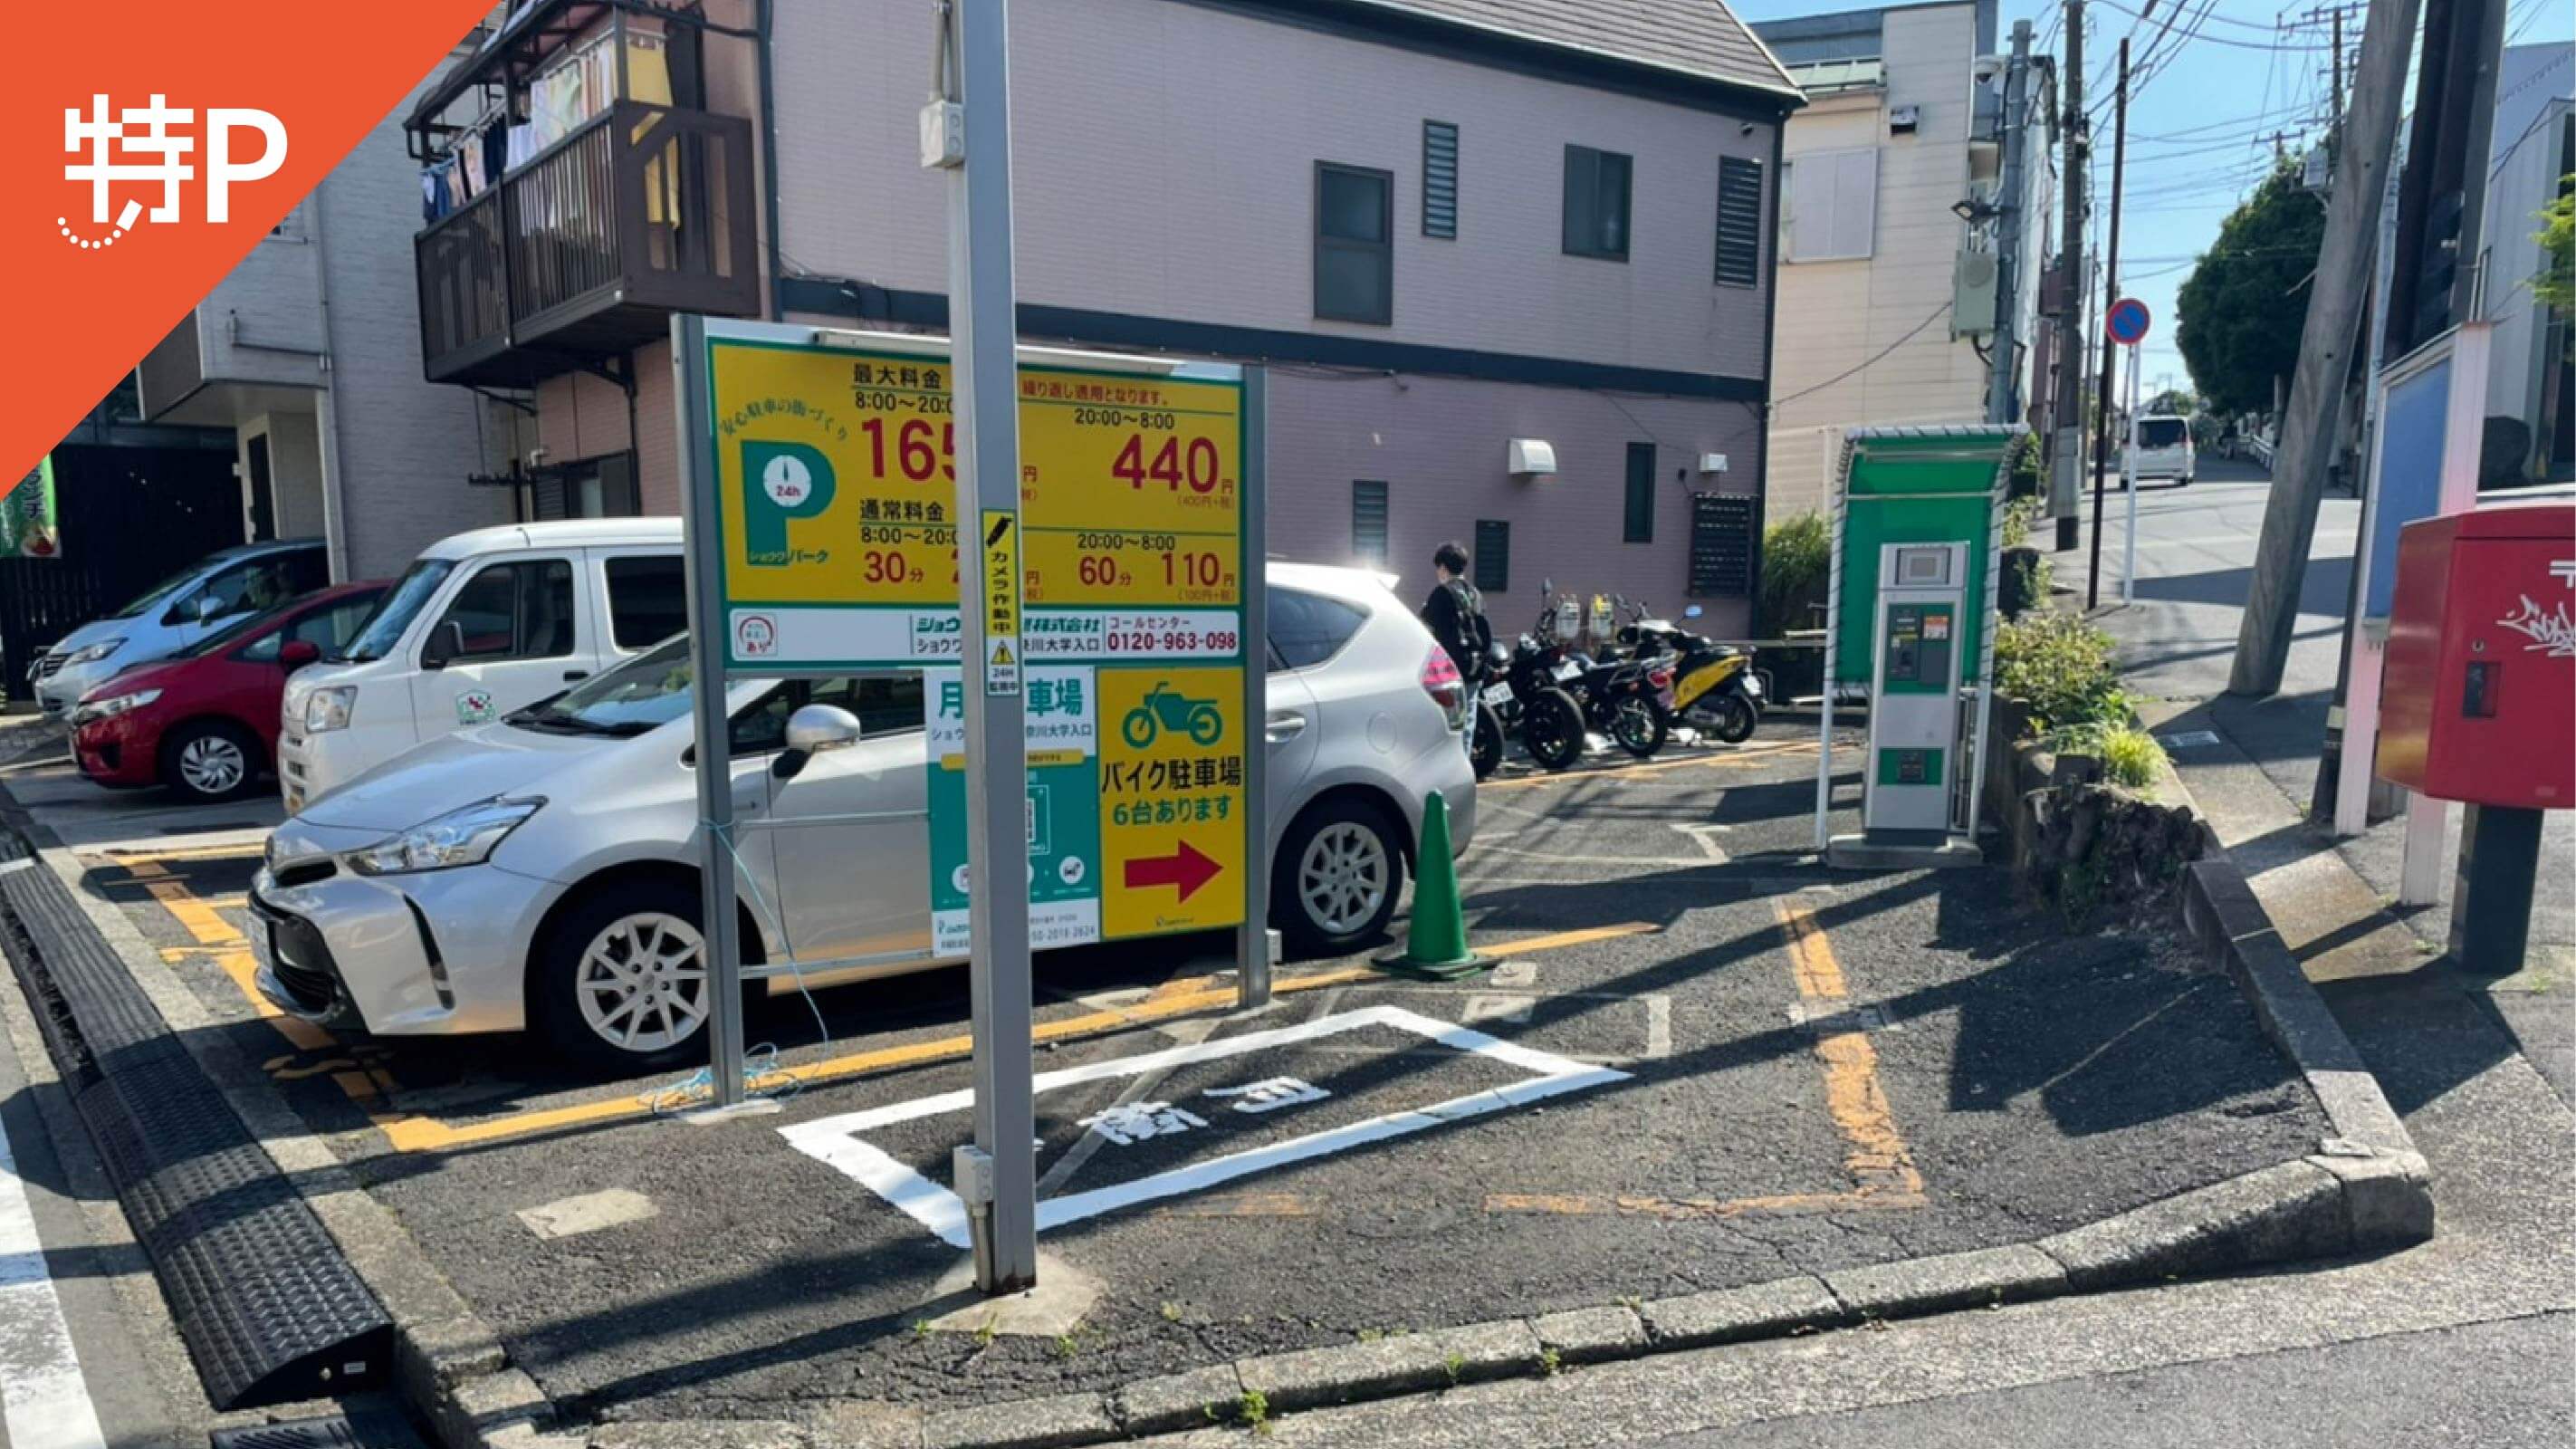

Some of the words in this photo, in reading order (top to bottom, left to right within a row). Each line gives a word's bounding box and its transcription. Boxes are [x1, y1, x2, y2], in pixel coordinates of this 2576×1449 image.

[854, 363, 942, 389] 最大料金
[776, 485, 801, 497] 24h
[860, 500, 943, 522] 通常料金
[991, 551, 1010, 633] カメラ作動中
[1107, 616, 1191, 630] コールセンター
[1107, 632, 1237, 650] 0120-963-098
[1027, 677, 1084, 718] 車場
[1102, 759, 1242, 793] バイク駐車場
[1113, 795, 1231, 826] 6台あります
